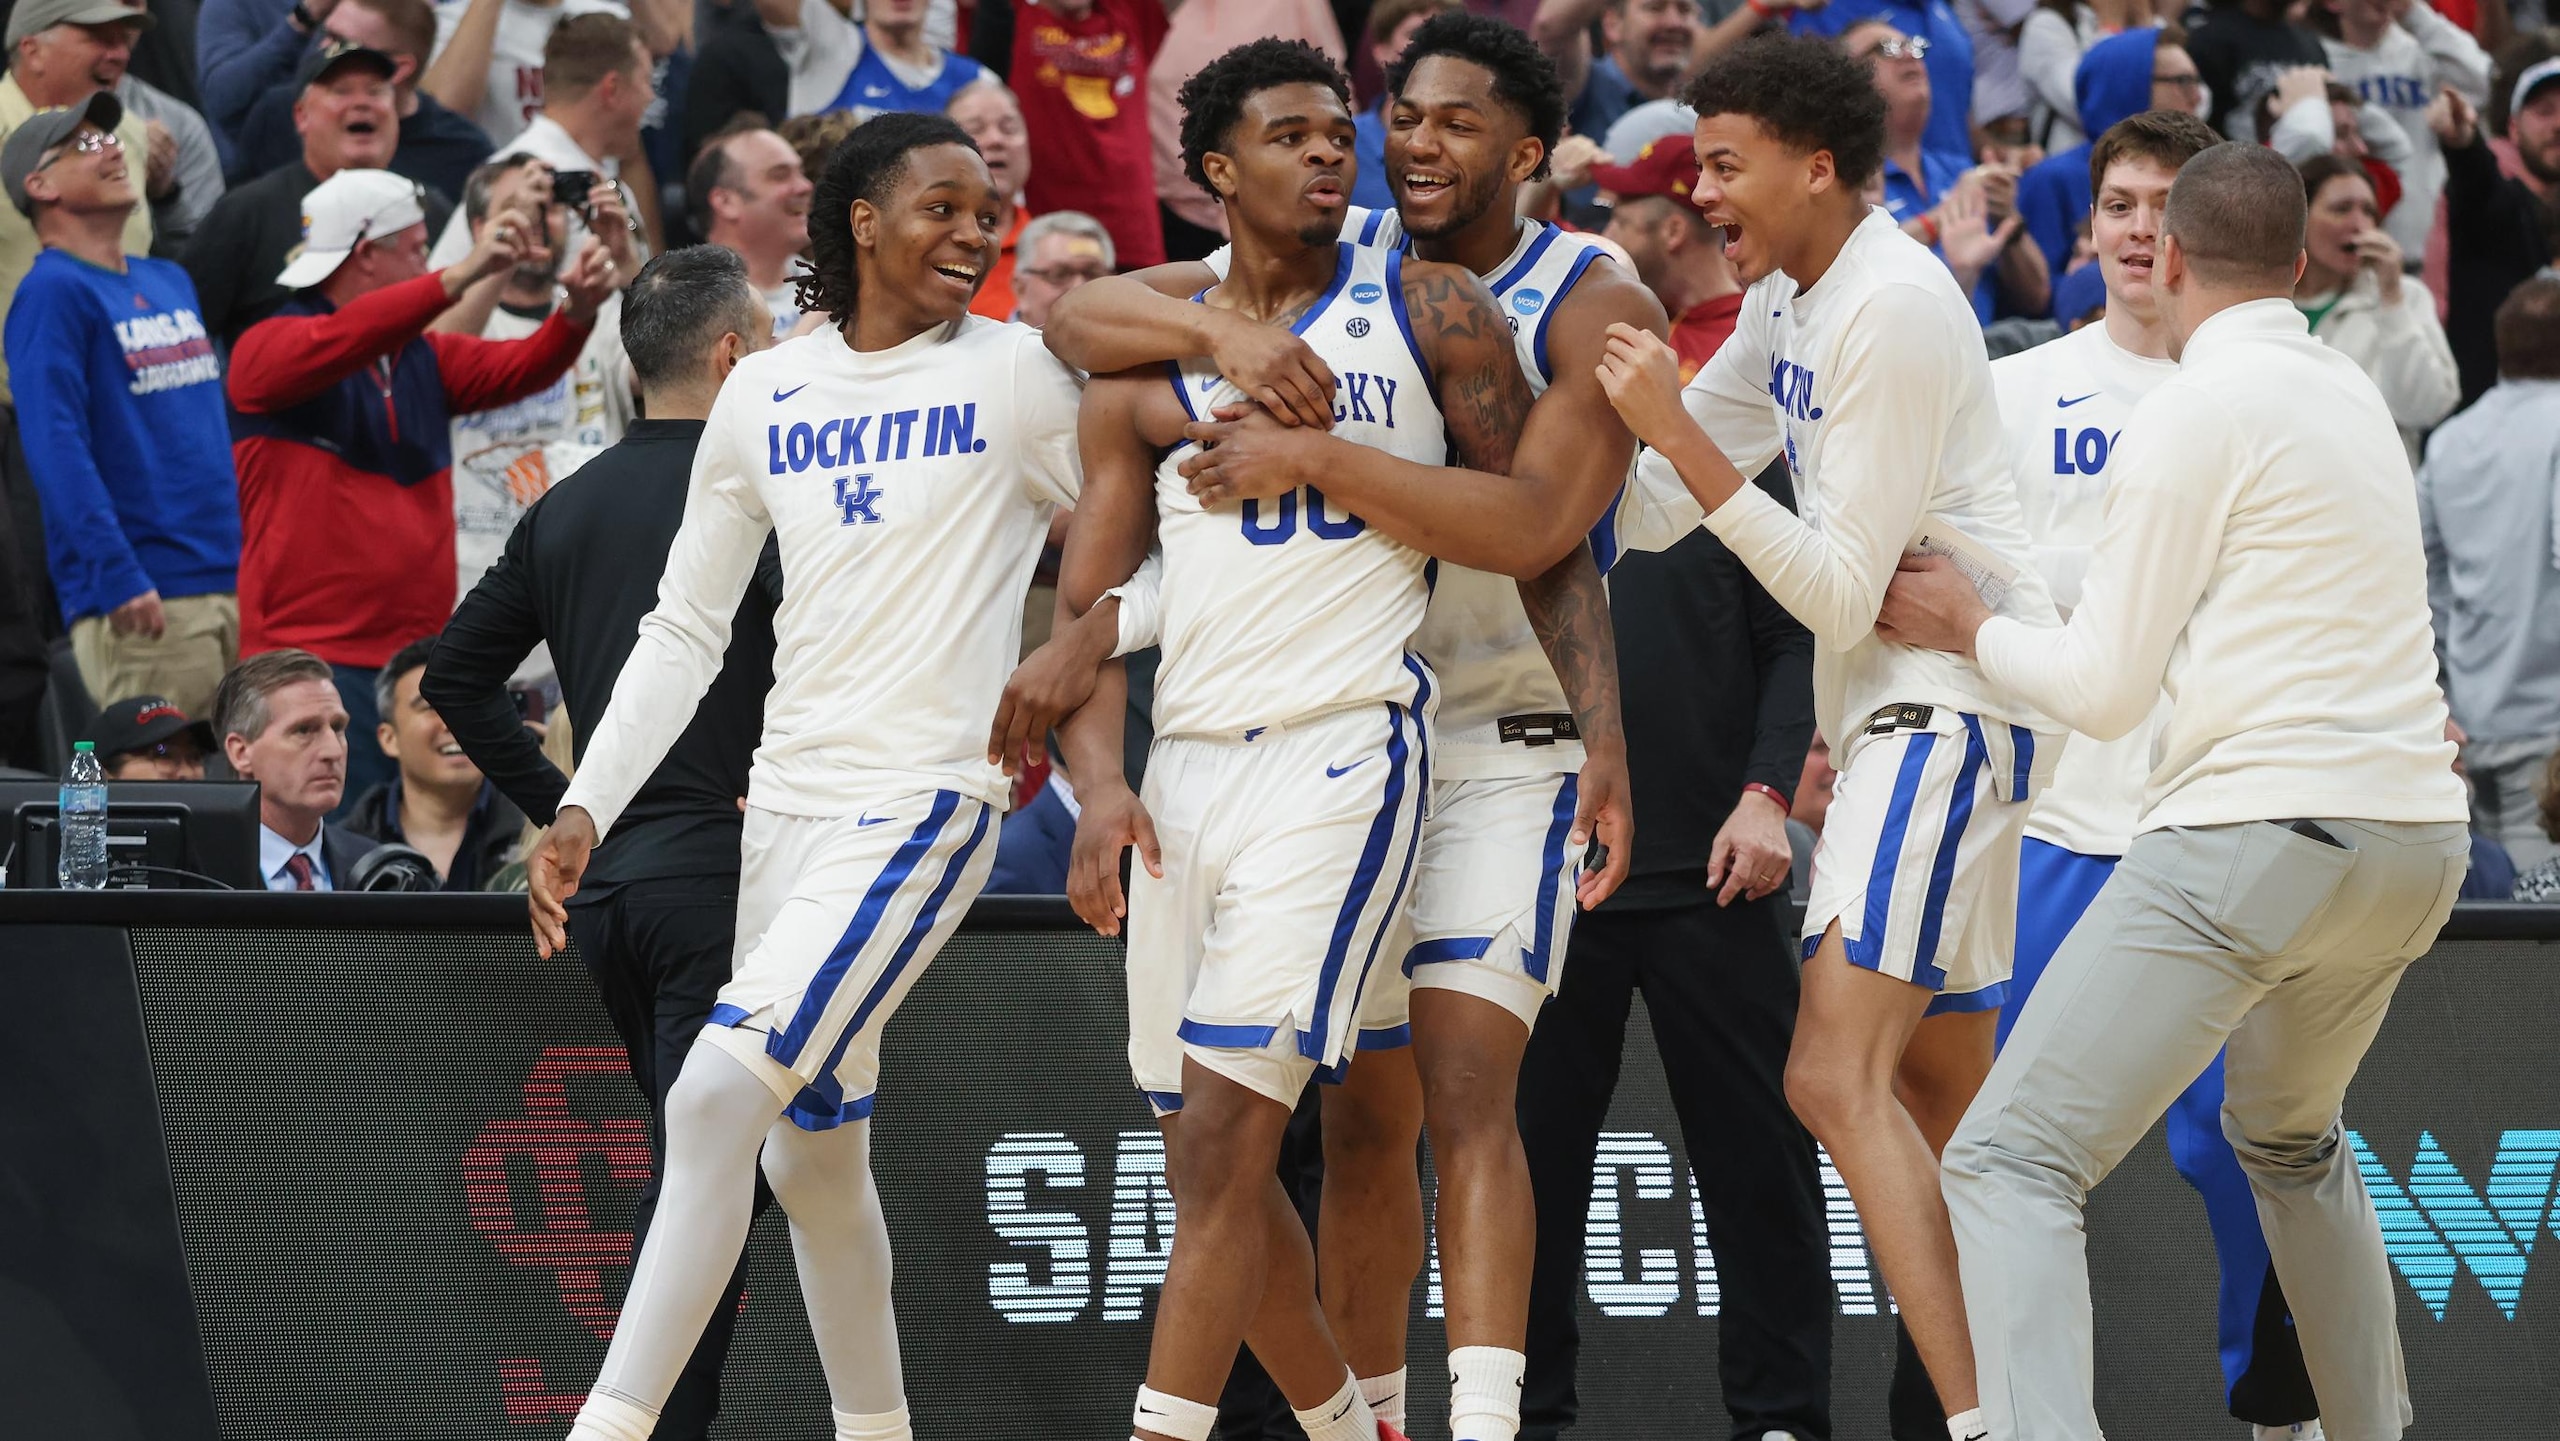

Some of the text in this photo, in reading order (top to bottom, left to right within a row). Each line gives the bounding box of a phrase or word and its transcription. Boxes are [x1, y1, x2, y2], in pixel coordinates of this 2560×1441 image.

[1354, 290, 1381, 299] NCAA
[1514, 296, 1541, 310] NCAA
[1347, 318, 1370, 337] SEC
[768, 402, 987, 475] LOCK IT IN.
[2054, 427, 2122, 475] LO
[832, 472, 884, 527] UK
[1902, 710, 1918, 721] 48
[1557, 720, 1571, 732] 48
